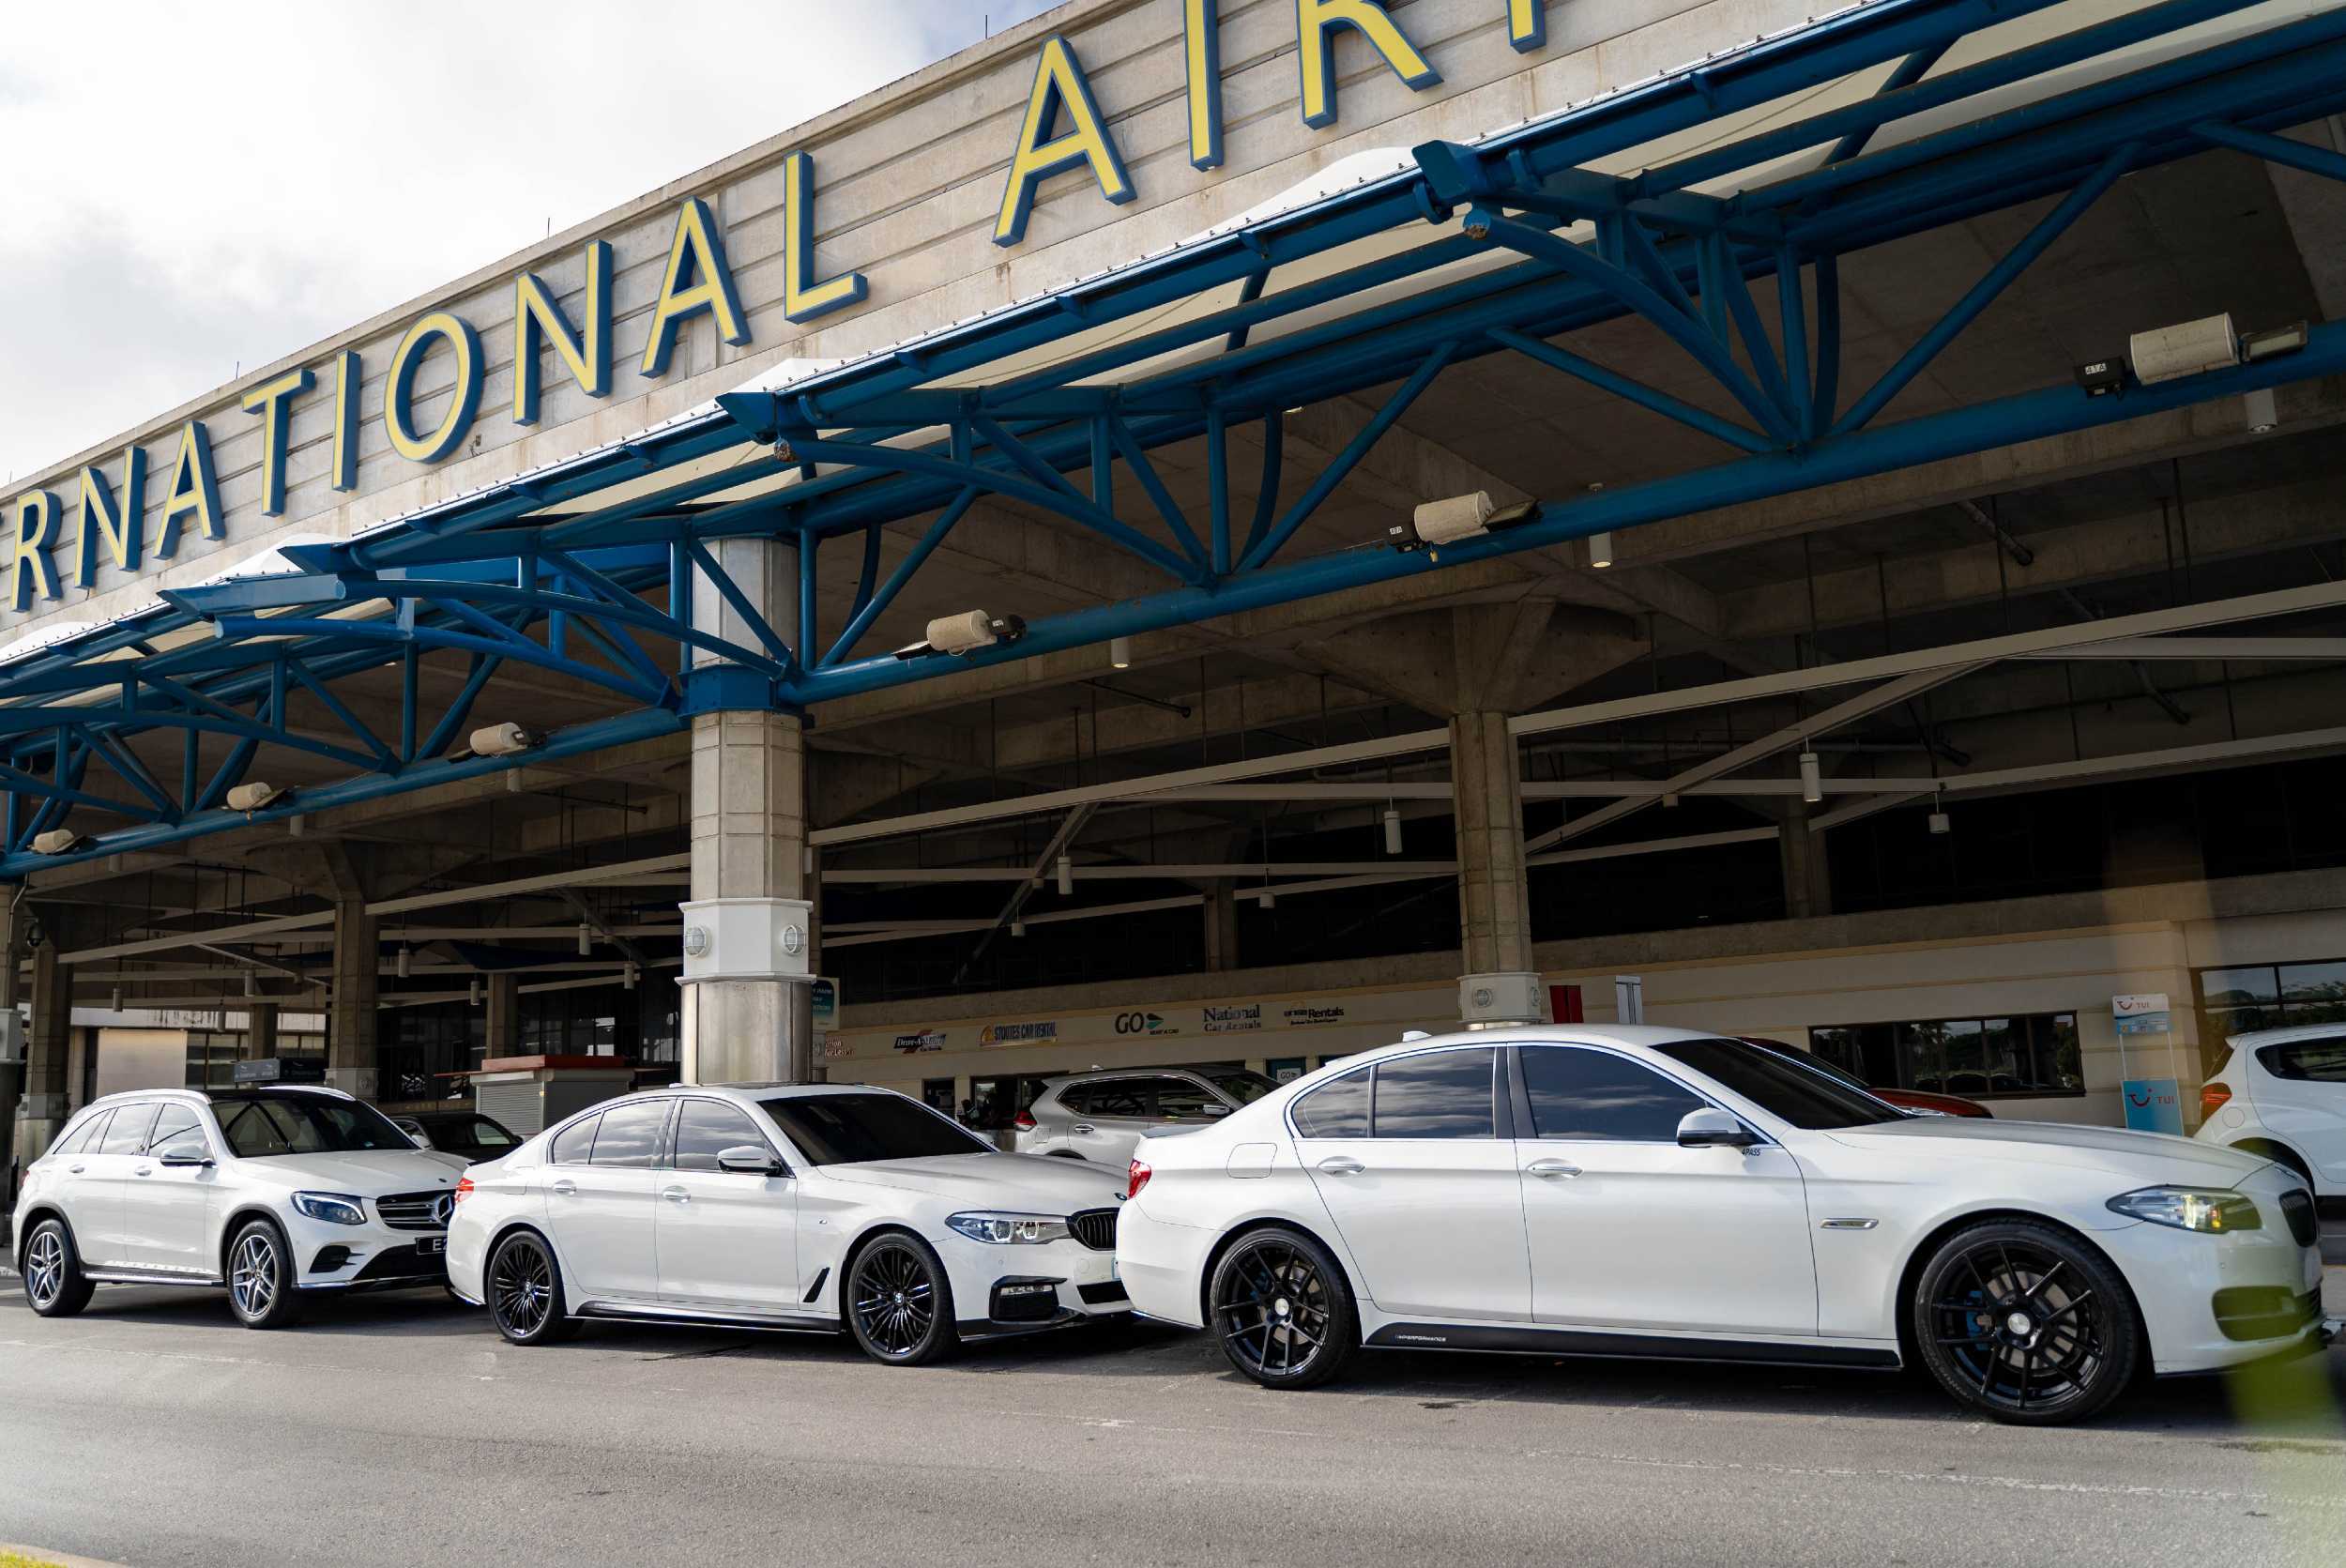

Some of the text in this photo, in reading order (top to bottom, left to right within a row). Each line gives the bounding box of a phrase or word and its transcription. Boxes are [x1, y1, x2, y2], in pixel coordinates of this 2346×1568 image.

[0, 0, 1546, 614] RNATIONAL AIR
[1203, 1004, 1259, 1022] National
[1308, 1006, 1344, 1018] Rentals
[1115, 1012, 1144, 1034] GO
[2157, 1095, 2174, 1104] TUI
